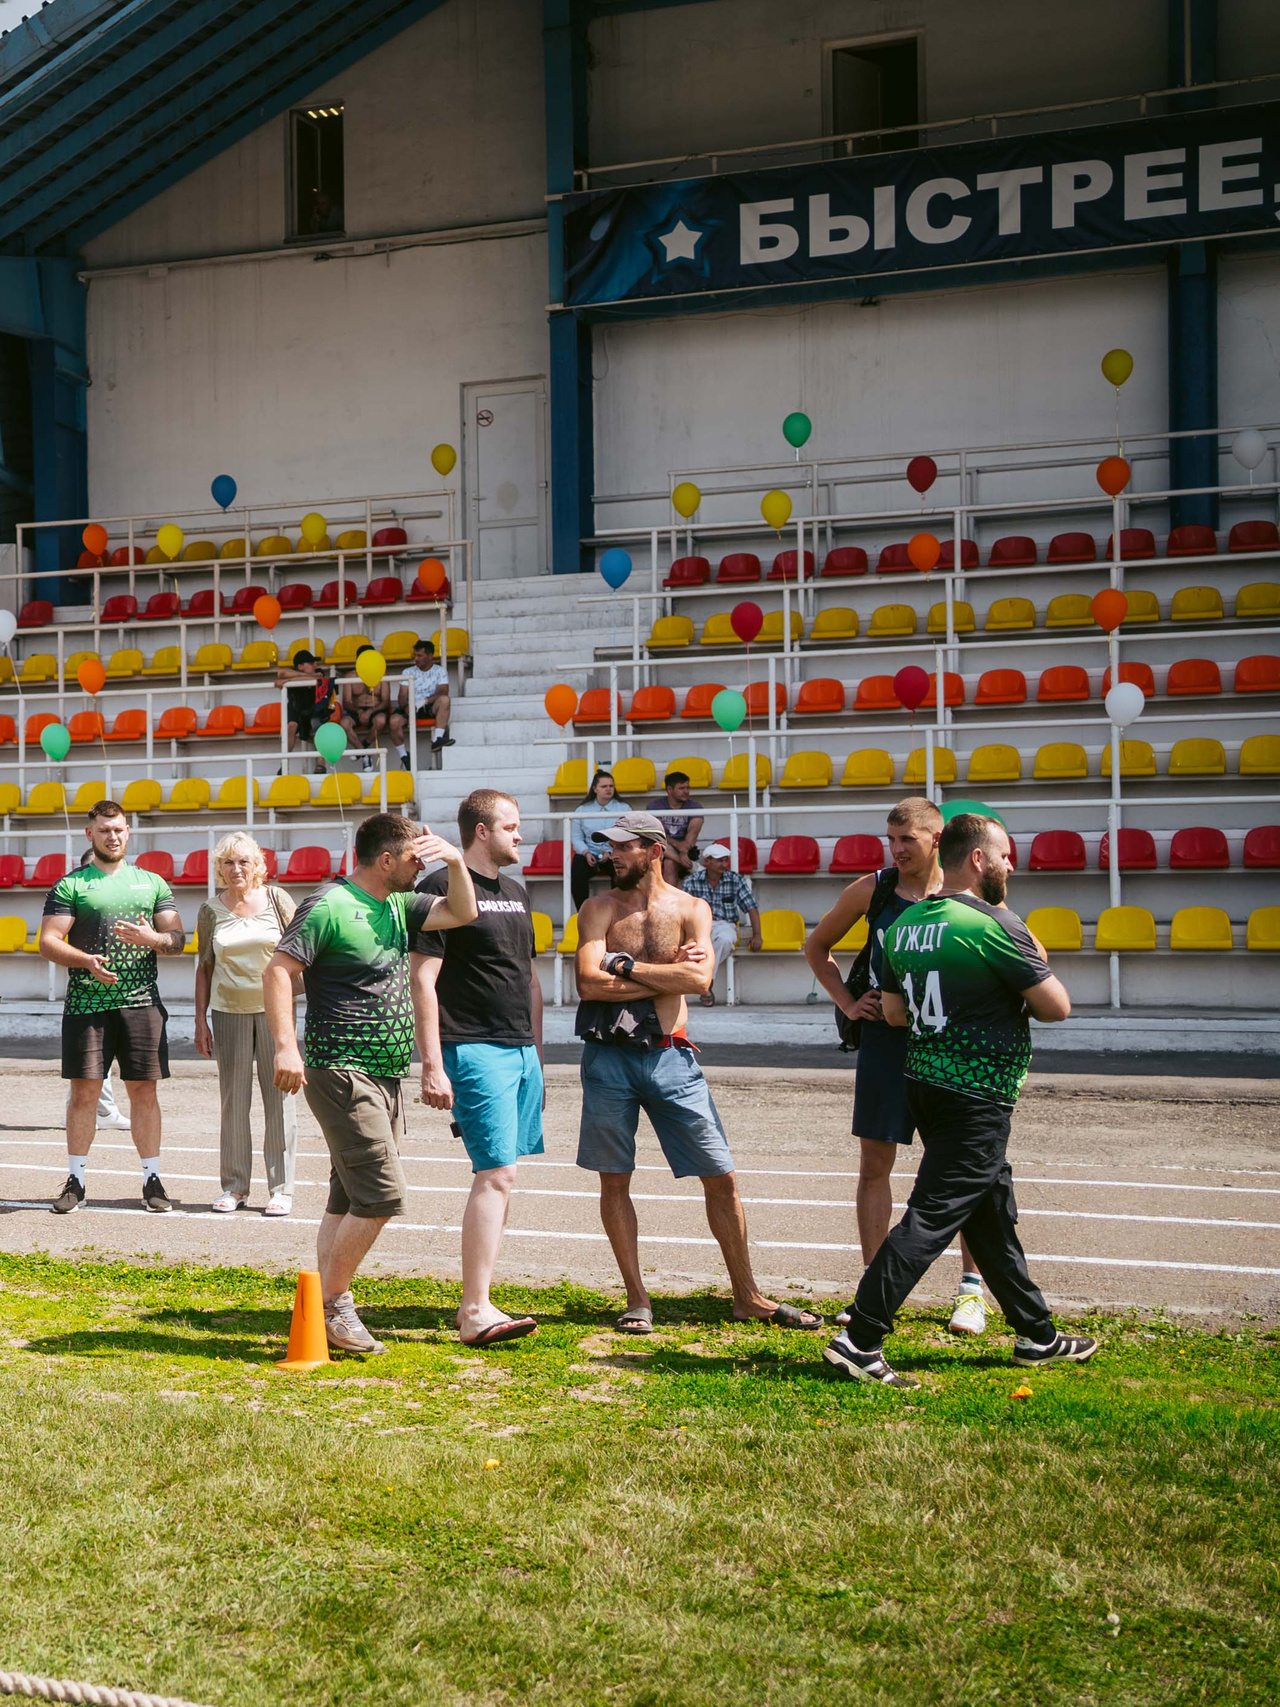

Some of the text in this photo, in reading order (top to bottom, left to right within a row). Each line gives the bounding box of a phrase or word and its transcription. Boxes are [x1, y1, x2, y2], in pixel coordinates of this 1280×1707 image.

[739, 137, 1280, 265] БЫСТРЕЕ
[477, 900, 526, 913] DARKSIDE
[893, 921, 949, 953] УЖДТ
[901, 970, 948, 1035] 14
